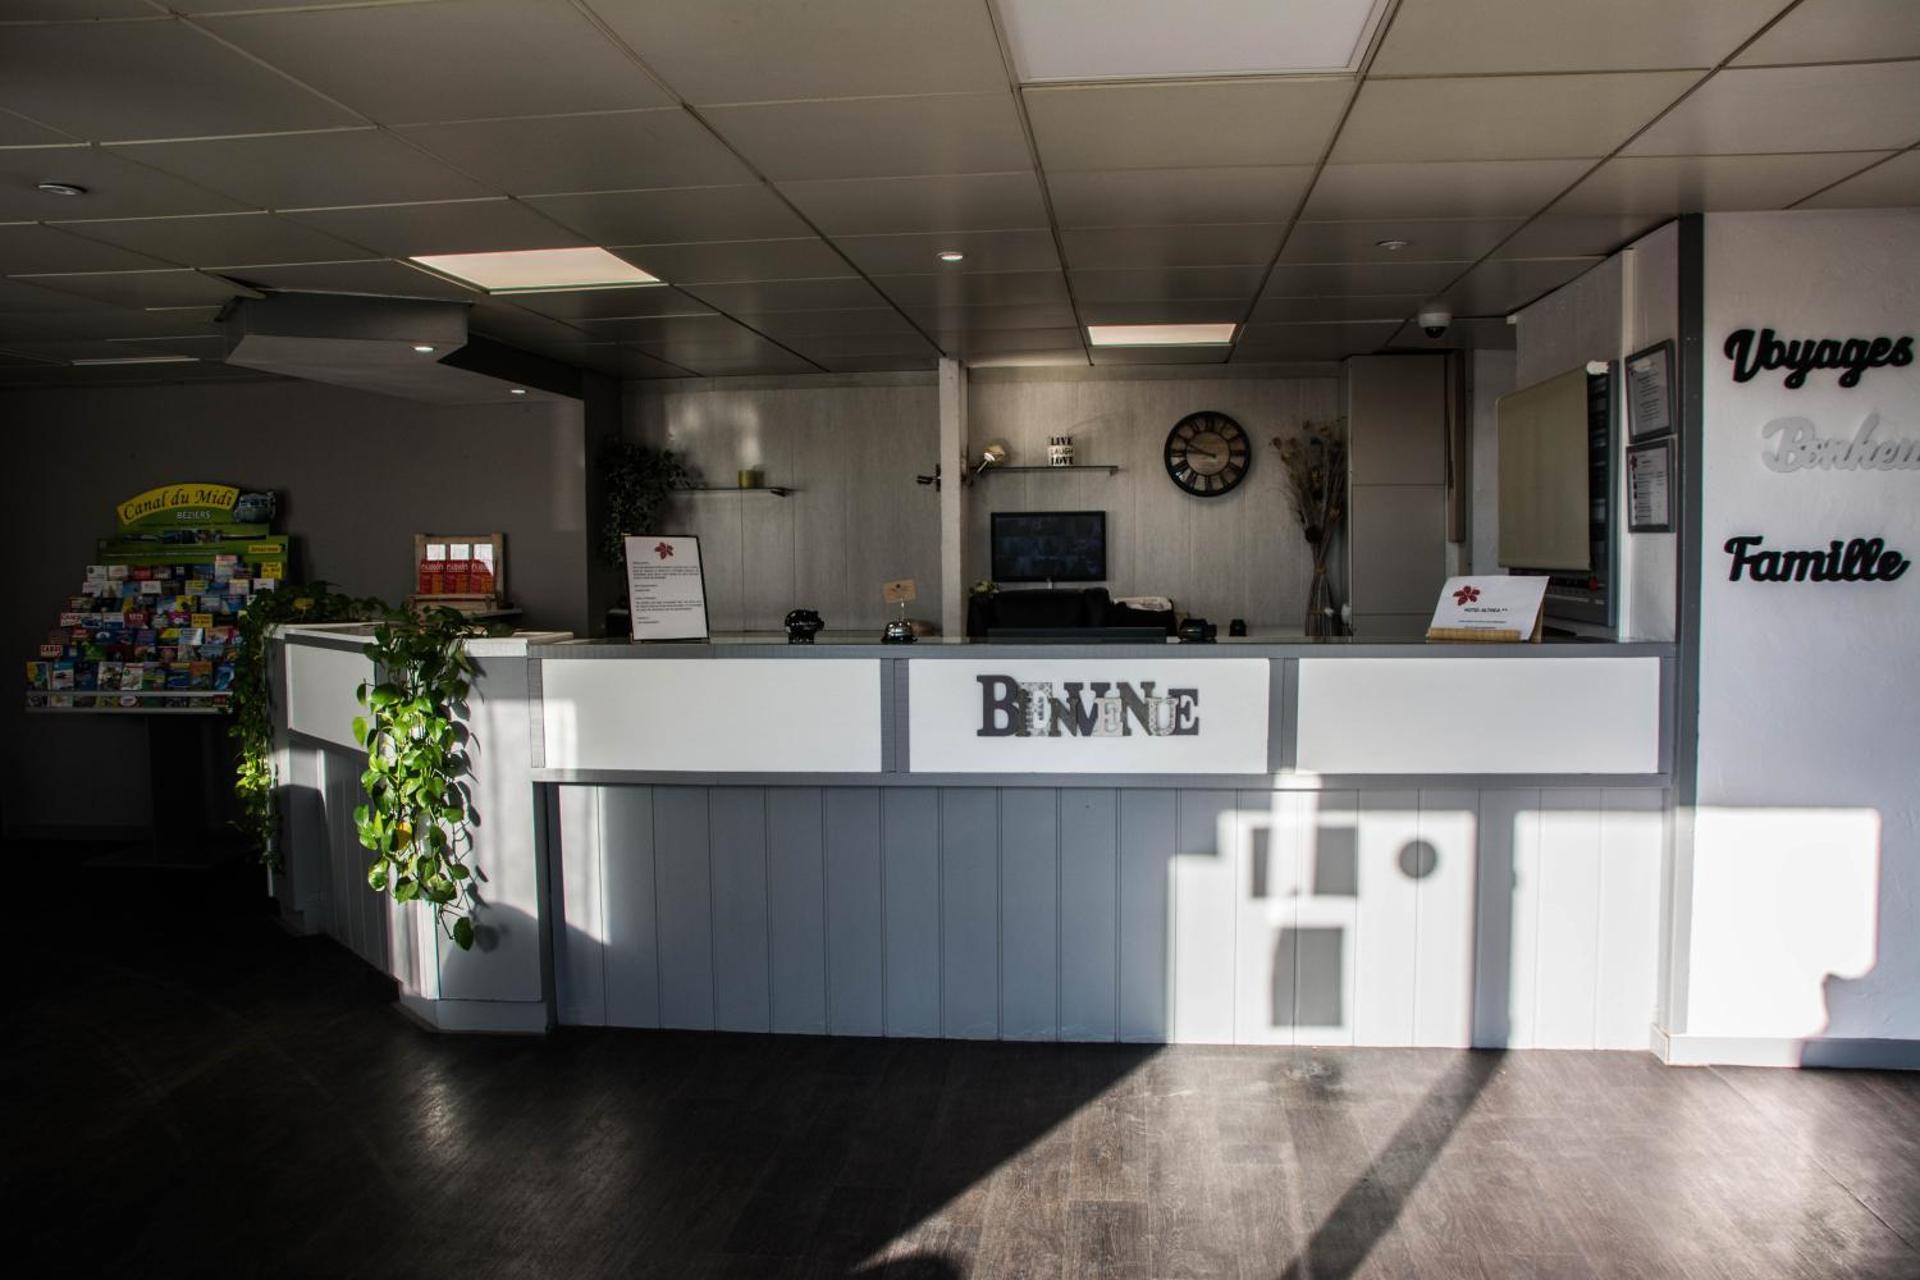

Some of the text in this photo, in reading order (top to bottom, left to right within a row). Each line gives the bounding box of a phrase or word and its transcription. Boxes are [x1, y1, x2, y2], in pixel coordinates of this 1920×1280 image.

[1723, 328, 1914, 390] Voyages
[1051, 437, 1073, 445] LIVE
[1051, 456, 1073, 465] LOVE
[1761, 410, 1920, 473] Bonheu
[123, 488, 232, 521] Canal du Midi
[1723, 535, 1912, 582] Famille
[976, 674, 1200, 738] BIENVENUE
